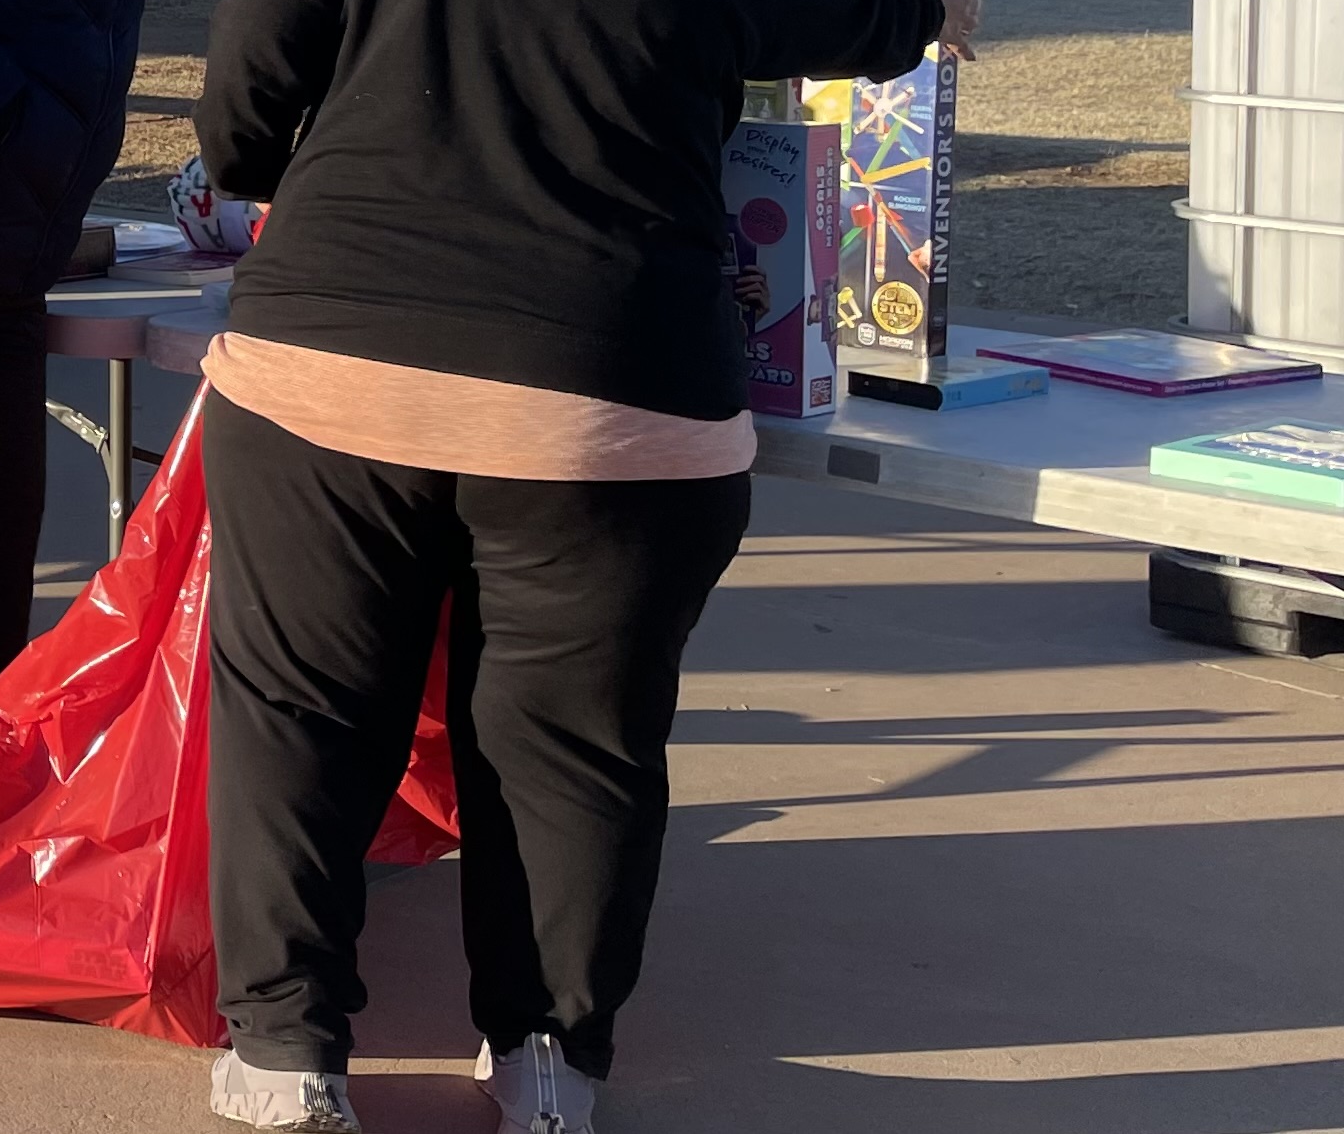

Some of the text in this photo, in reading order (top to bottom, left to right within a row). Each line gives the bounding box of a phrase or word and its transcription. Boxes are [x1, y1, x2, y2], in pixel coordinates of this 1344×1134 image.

[728, 149, 796, 189] Desires!
[745, 129, 800, 165] Display
[933, 44, 955, 284] INVENTOR'S BOX
[826, 147, 834, 198] BOARD
[816, 164, 825, 231] GOALS
[879, 301, 916, 316] STEM
